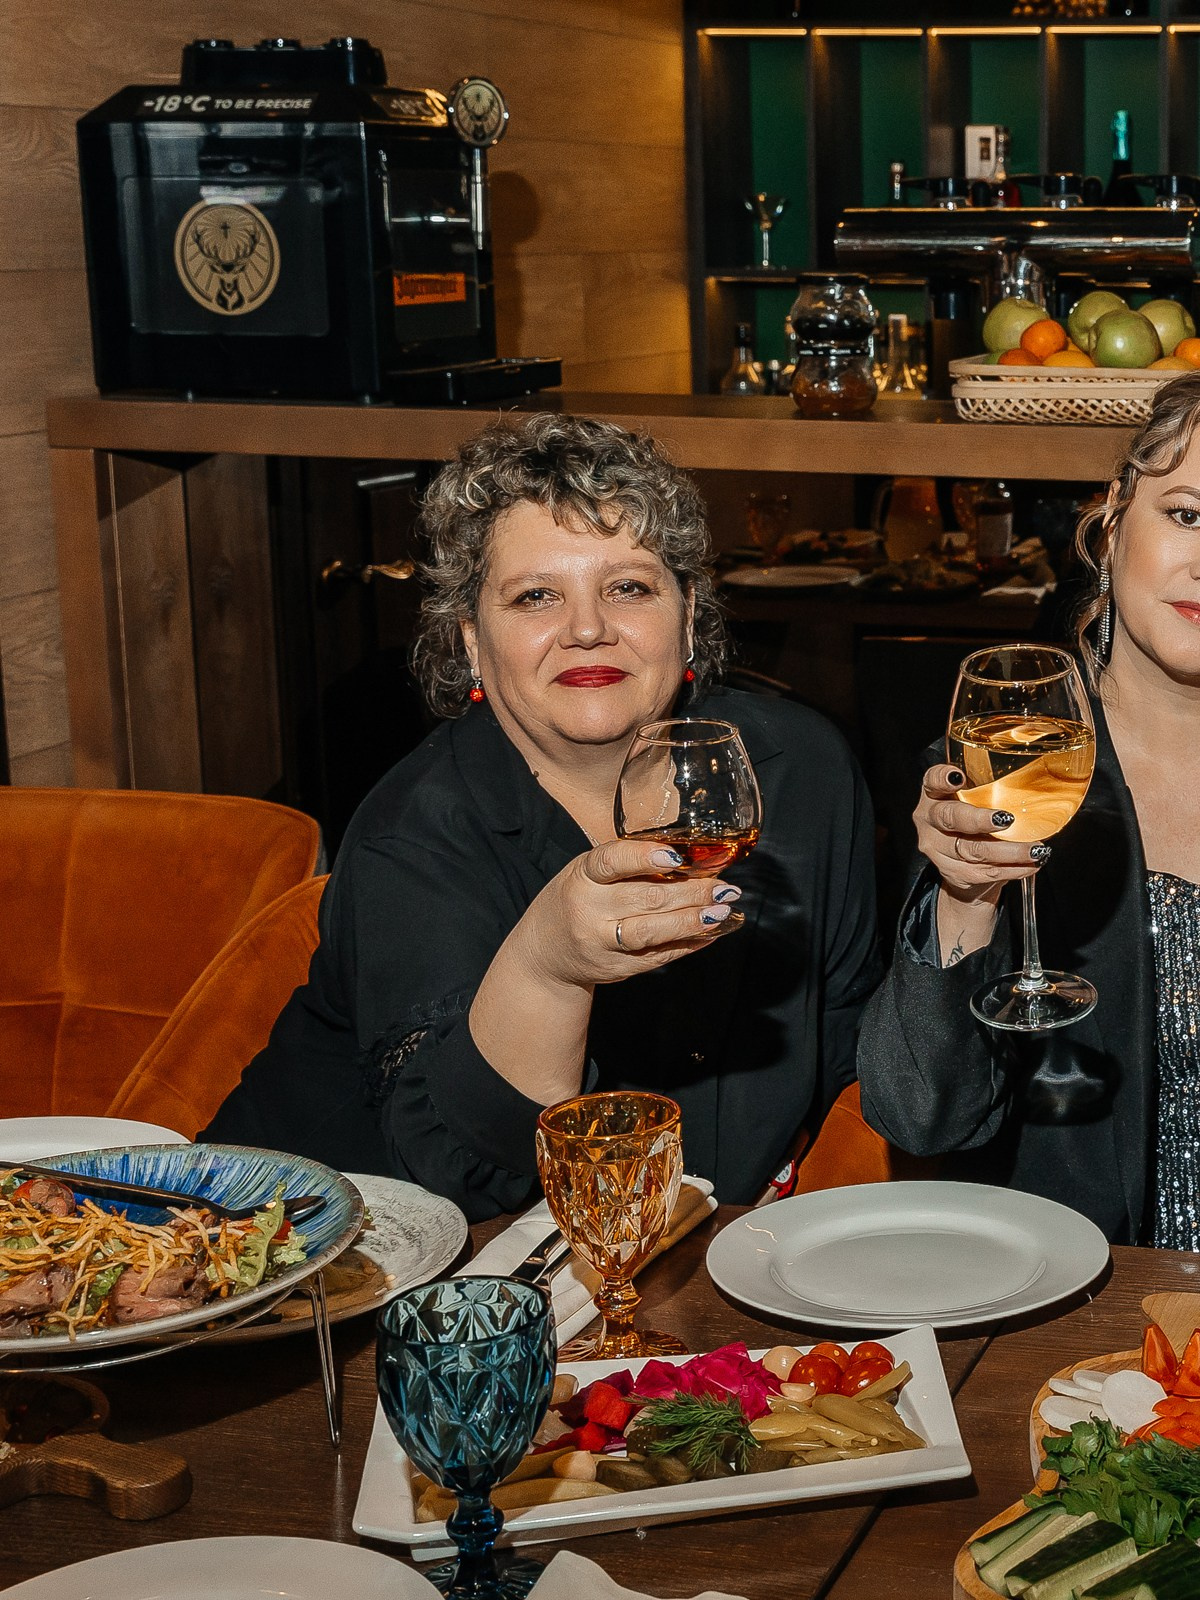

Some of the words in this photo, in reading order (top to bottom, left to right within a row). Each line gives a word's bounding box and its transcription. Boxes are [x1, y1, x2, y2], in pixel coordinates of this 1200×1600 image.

[143, 95, 212, 113] -18°C
[214, 98, 233, 110] TO
[234, 98, 253, 110] BE
[254, 98, 313, 110] PRECISE
